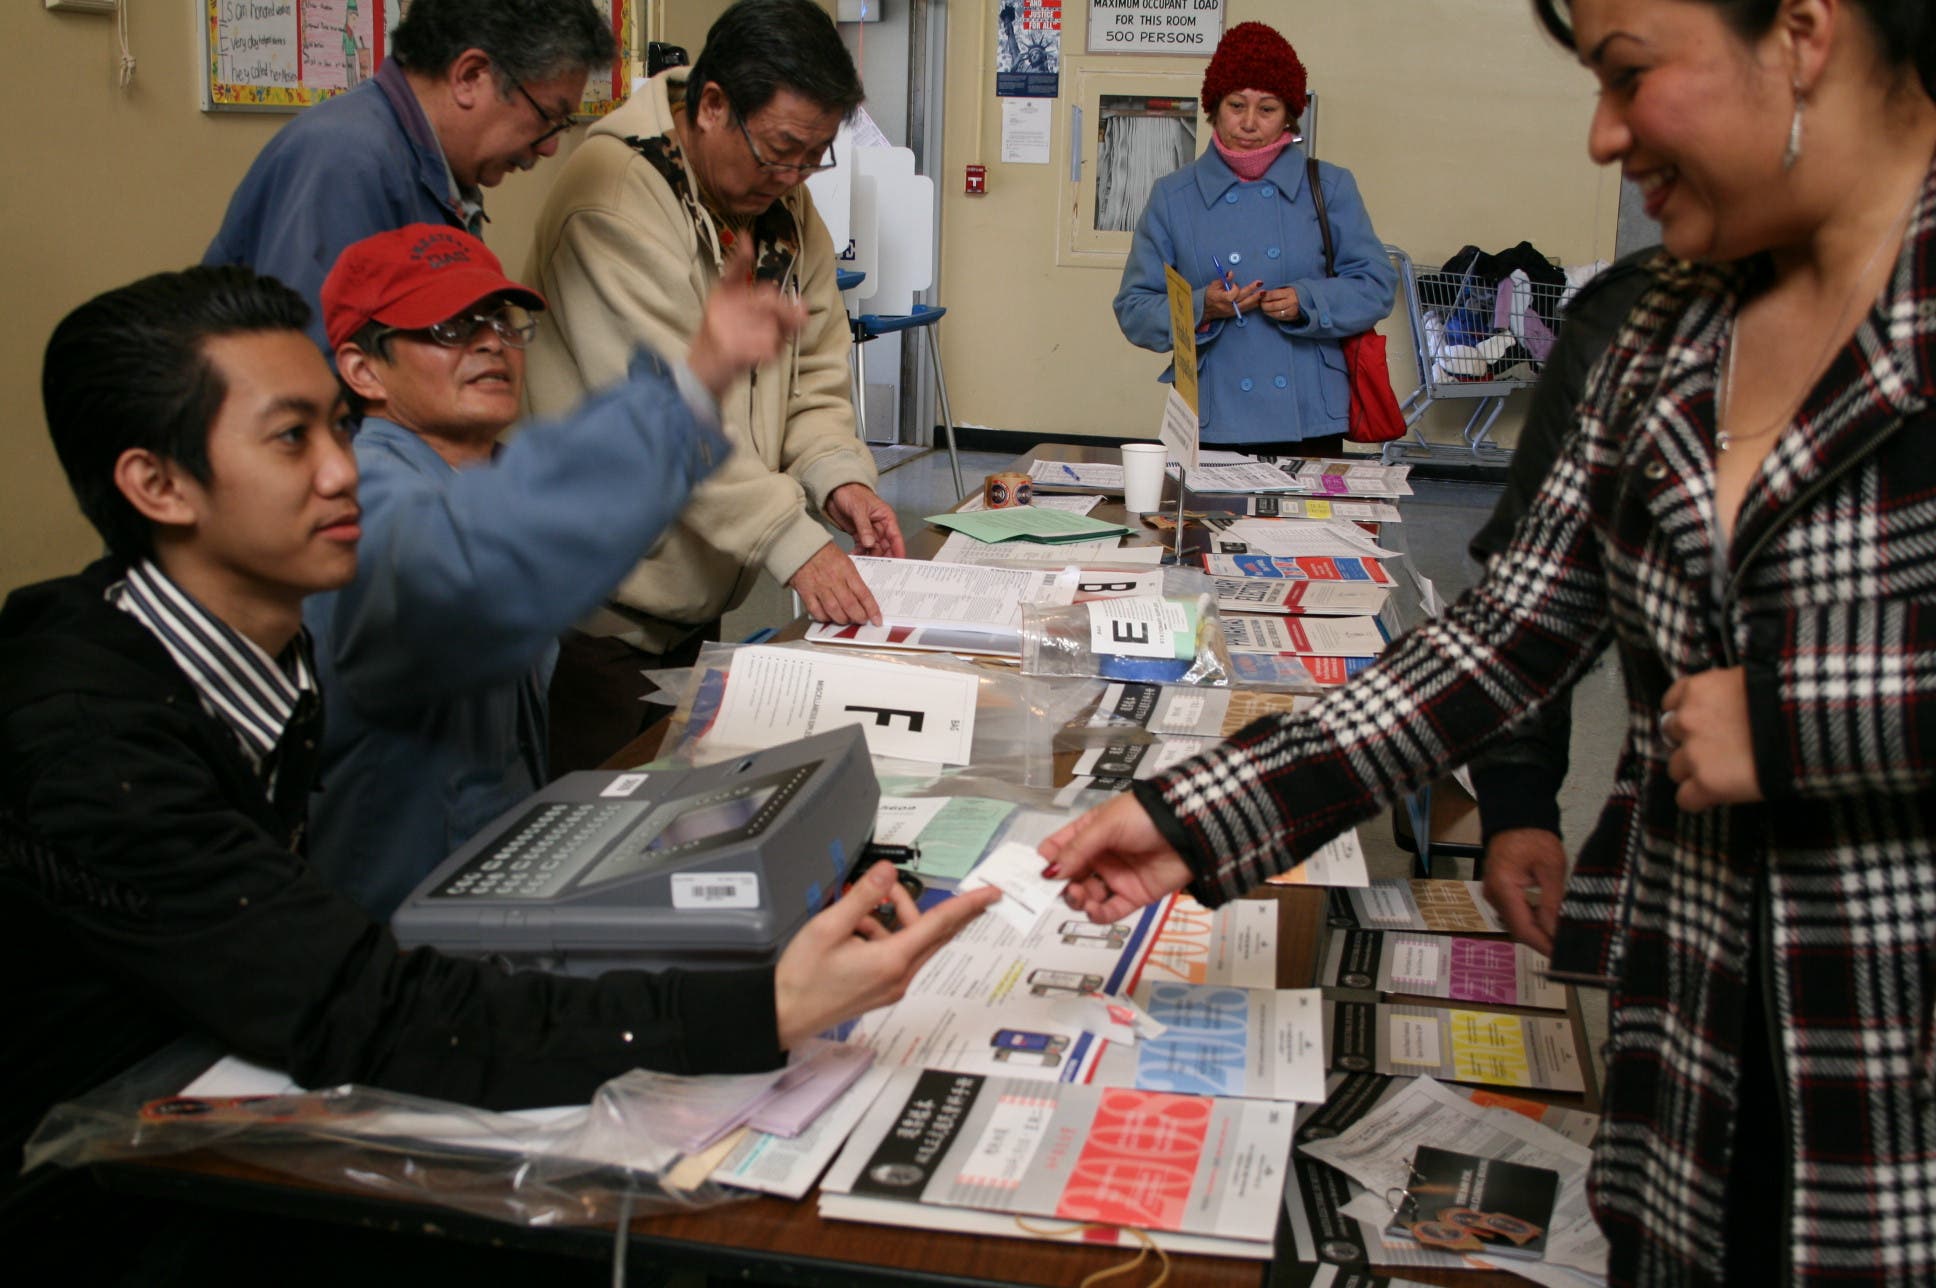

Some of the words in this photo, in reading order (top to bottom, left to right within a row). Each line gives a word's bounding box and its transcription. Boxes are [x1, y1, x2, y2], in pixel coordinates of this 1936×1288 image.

[1094, 0, 1139, 9] MAXIMUM
[1142, 0, 1187, 10] OCCUPANT
[1194, 0, 1219, 10] LOAD
[1030, 10, 1055, 19] JUSTICE
[1115, 14, 1134, 26] FOR
[1140, 15, 1162, 27] THIS
[1166, 16, 1197, 27] ROOM
[1106, 31, 1135, 42] 500
[1140, 32, 1204, 44] PERSONS
[1077, 581, 1137, 592] B
[1112, 620, 1149, 644] E
[844, 705, 925, 733] F
[1057, 1087, 1213, 1231] 2008
